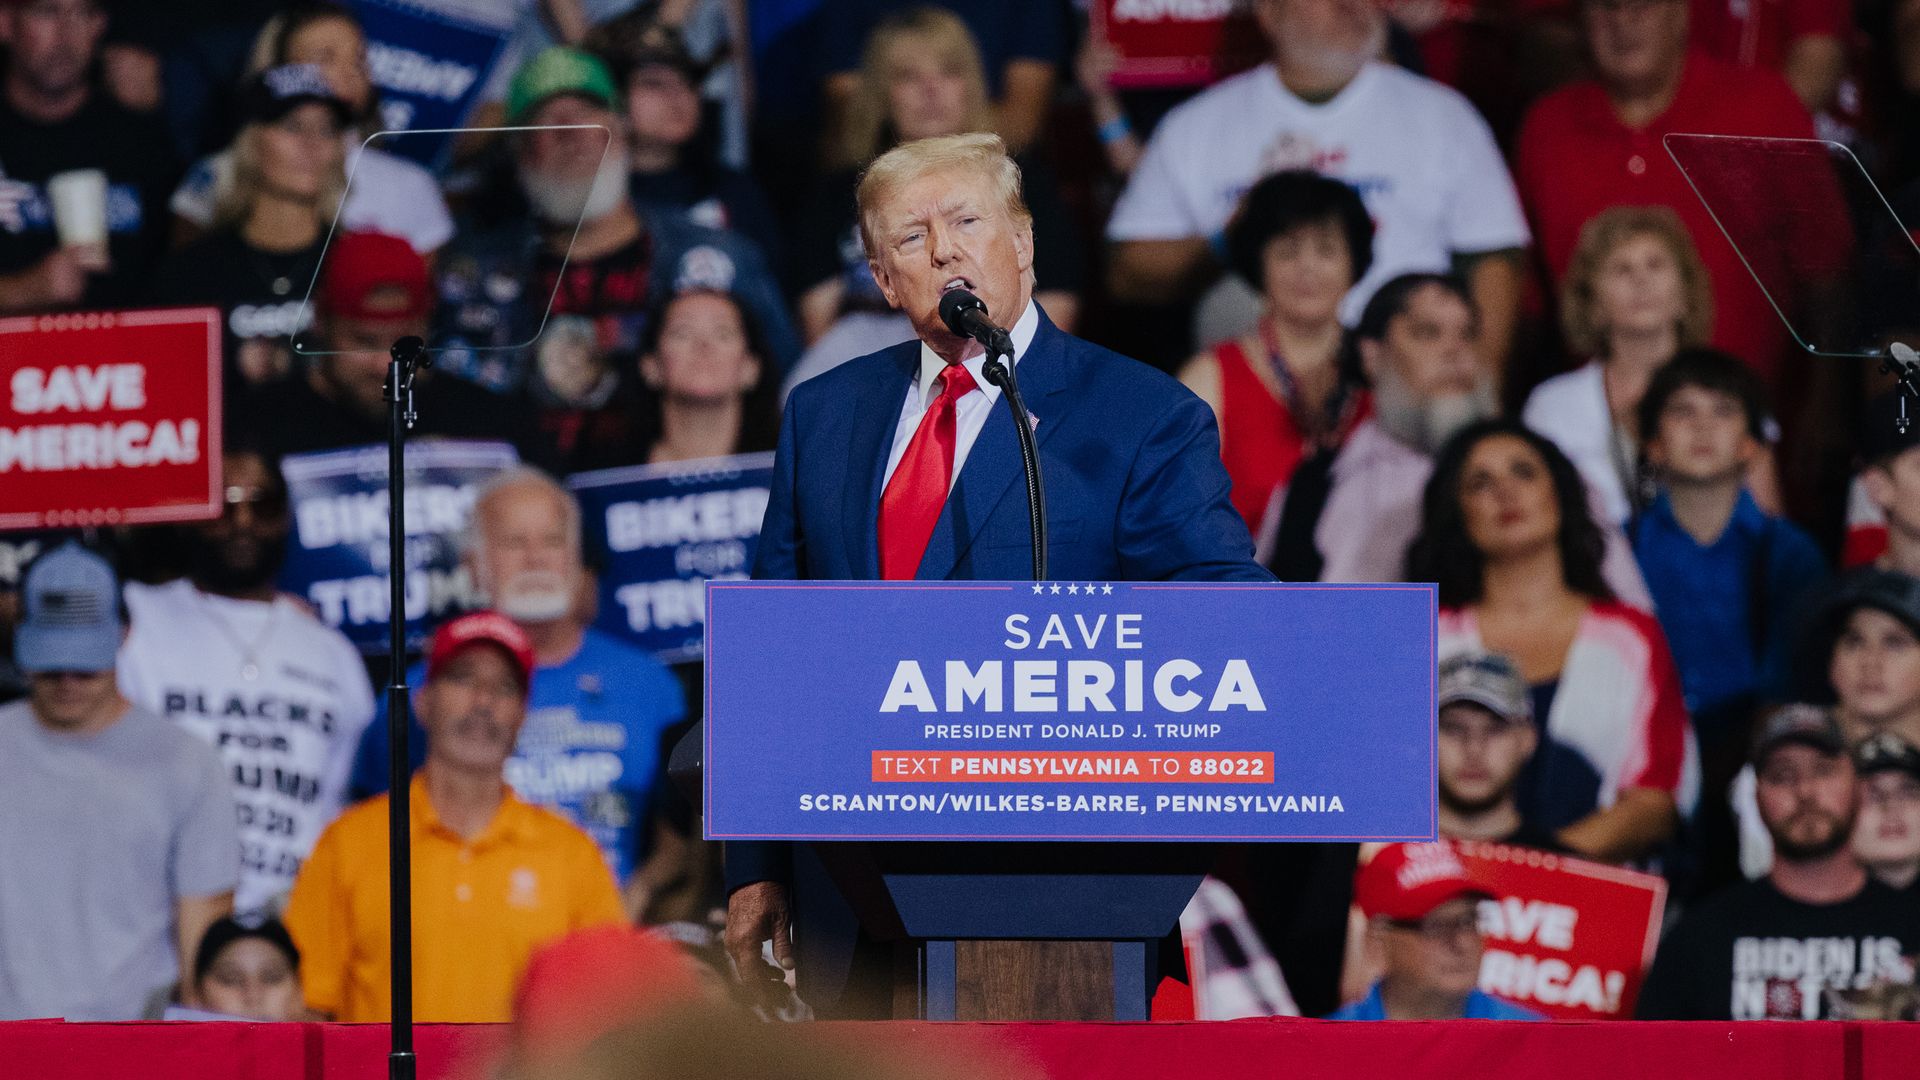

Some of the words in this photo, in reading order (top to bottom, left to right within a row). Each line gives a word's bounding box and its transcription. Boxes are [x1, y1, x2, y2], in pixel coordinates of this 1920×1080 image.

[10, 362, 147, 414] SAVE
[0, 418, 200, 473] MERICA!
[299, 483, 478, 549] BIKER
[605, 487, 771, 552] BIKER
[308, 567, 480, 628] TRUM
[1004, 613, 1143, 650] SAVE
[879, 659, 1267, 713] AMERICA
[924, 724, 1034, 739] PRESIDENT
[1041, 724, 1125, 739] DONALD
[1132, 724, 1147, 739] J.
[1154, 723, 1221, 738] TRUMP
[234, 762, 319, 804] UMP
[881, 757, 942, 775] TEXT
[951, 757, 1140, 776] PENNSYLVANIA
[1148, 758, 1180, 776] TO
[1189, 758, 1264, 776] 88022
[799, 792, 1147, 815] SCRANTON/WILKES-BARRE,
[1156, 795, 1345, 813] PENNSYLVANIA
[1476, 896, 1578, 951] AVE
[1477, 949, 1626, 1014] RICA!
[1733, 935, 1857, 990] BIDEN
